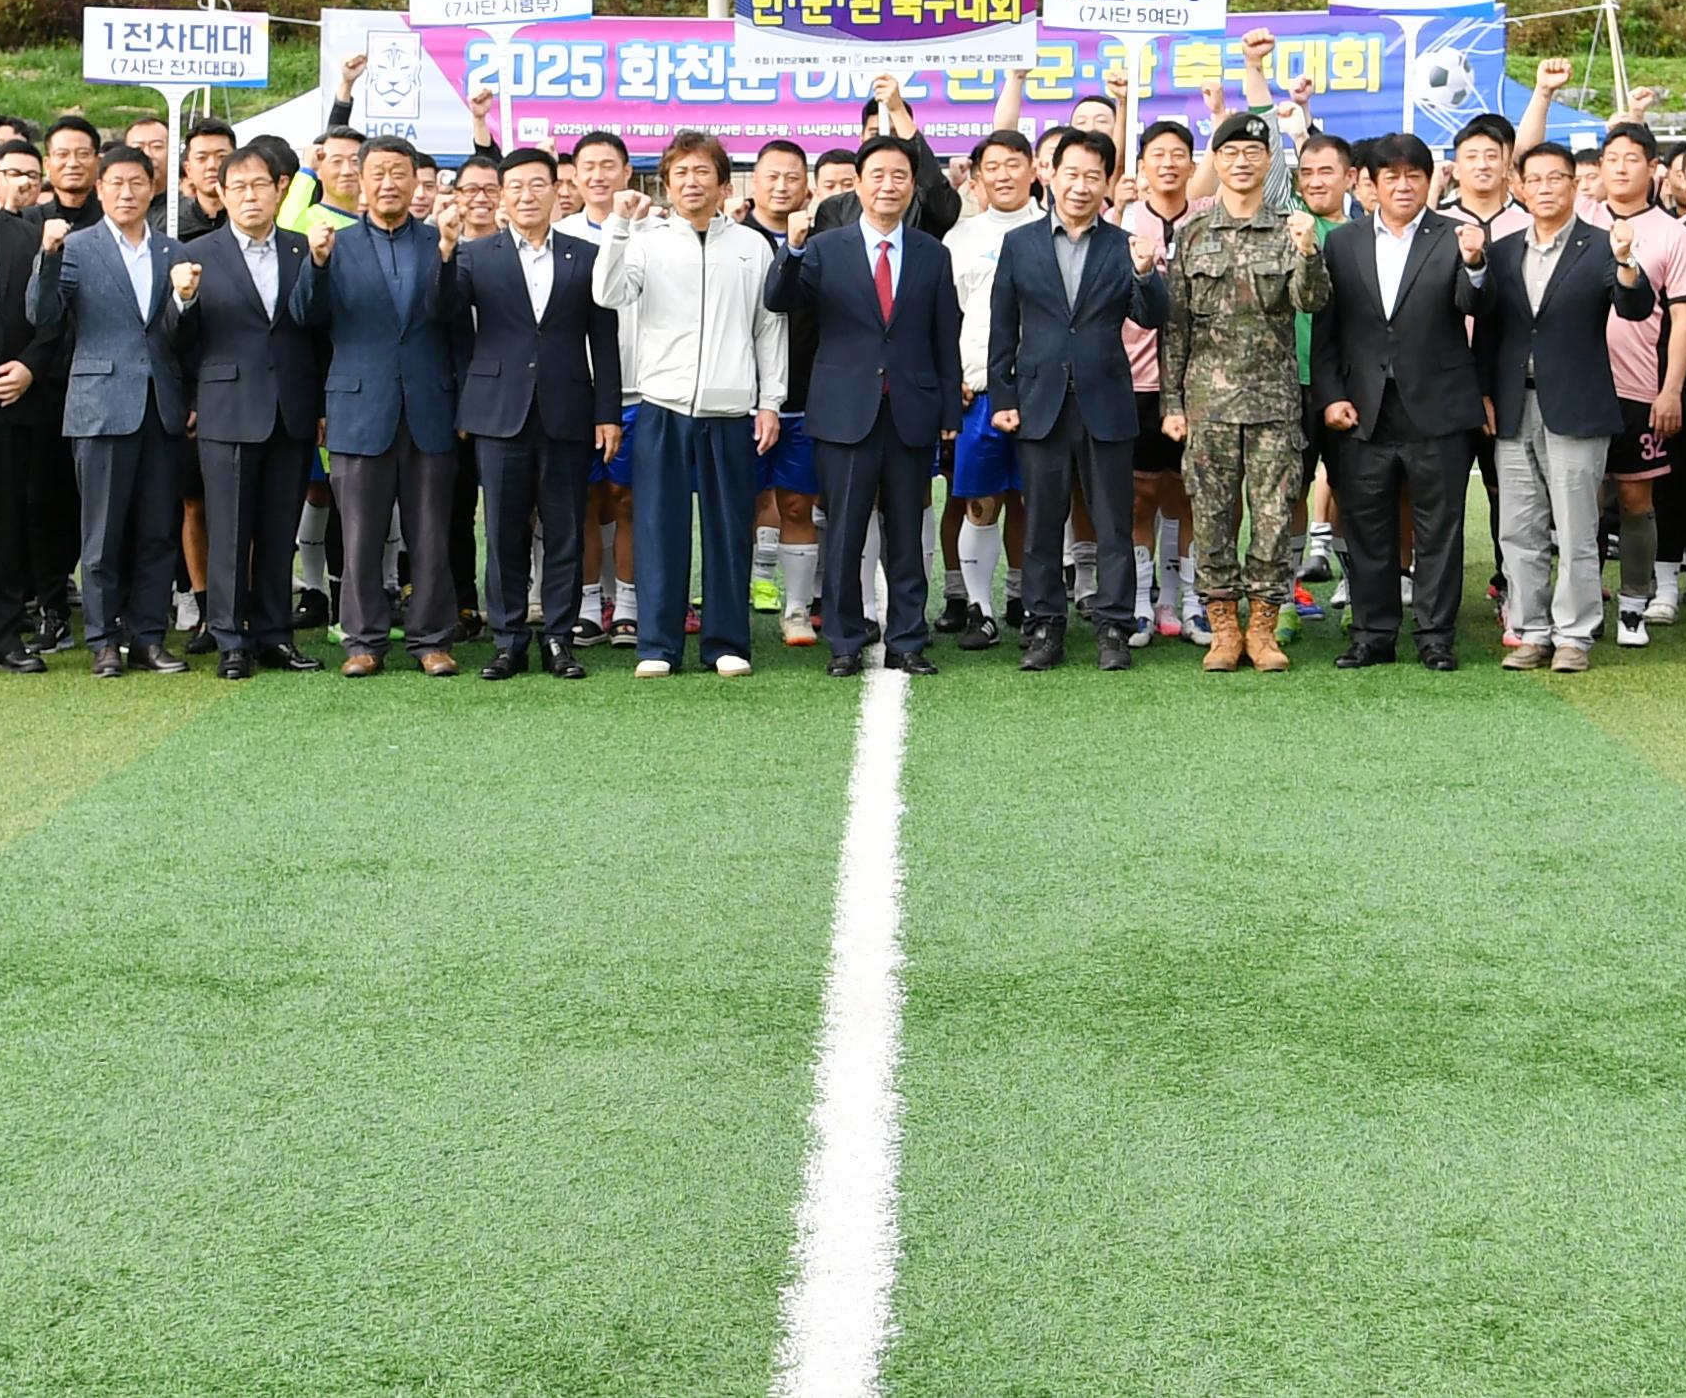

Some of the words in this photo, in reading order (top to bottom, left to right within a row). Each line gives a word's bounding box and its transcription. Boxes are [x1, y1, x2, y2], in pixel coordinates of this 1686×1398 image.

[444, 0, 496, 18] (7사단
[1079, 5, 1131, 24] (7사단
[1137, 7, 1189, 26] 5여단)
[103, 21, 252, 55] 1전차대대
[110, 58, 163, 76] (7사단
[170, 59, 245, 77] 전차대대)
[467, 42, 604, 98] 2025
[1172, 37, 1381, 94] 축구대회
[1639, 430, 1668, 461] 32
